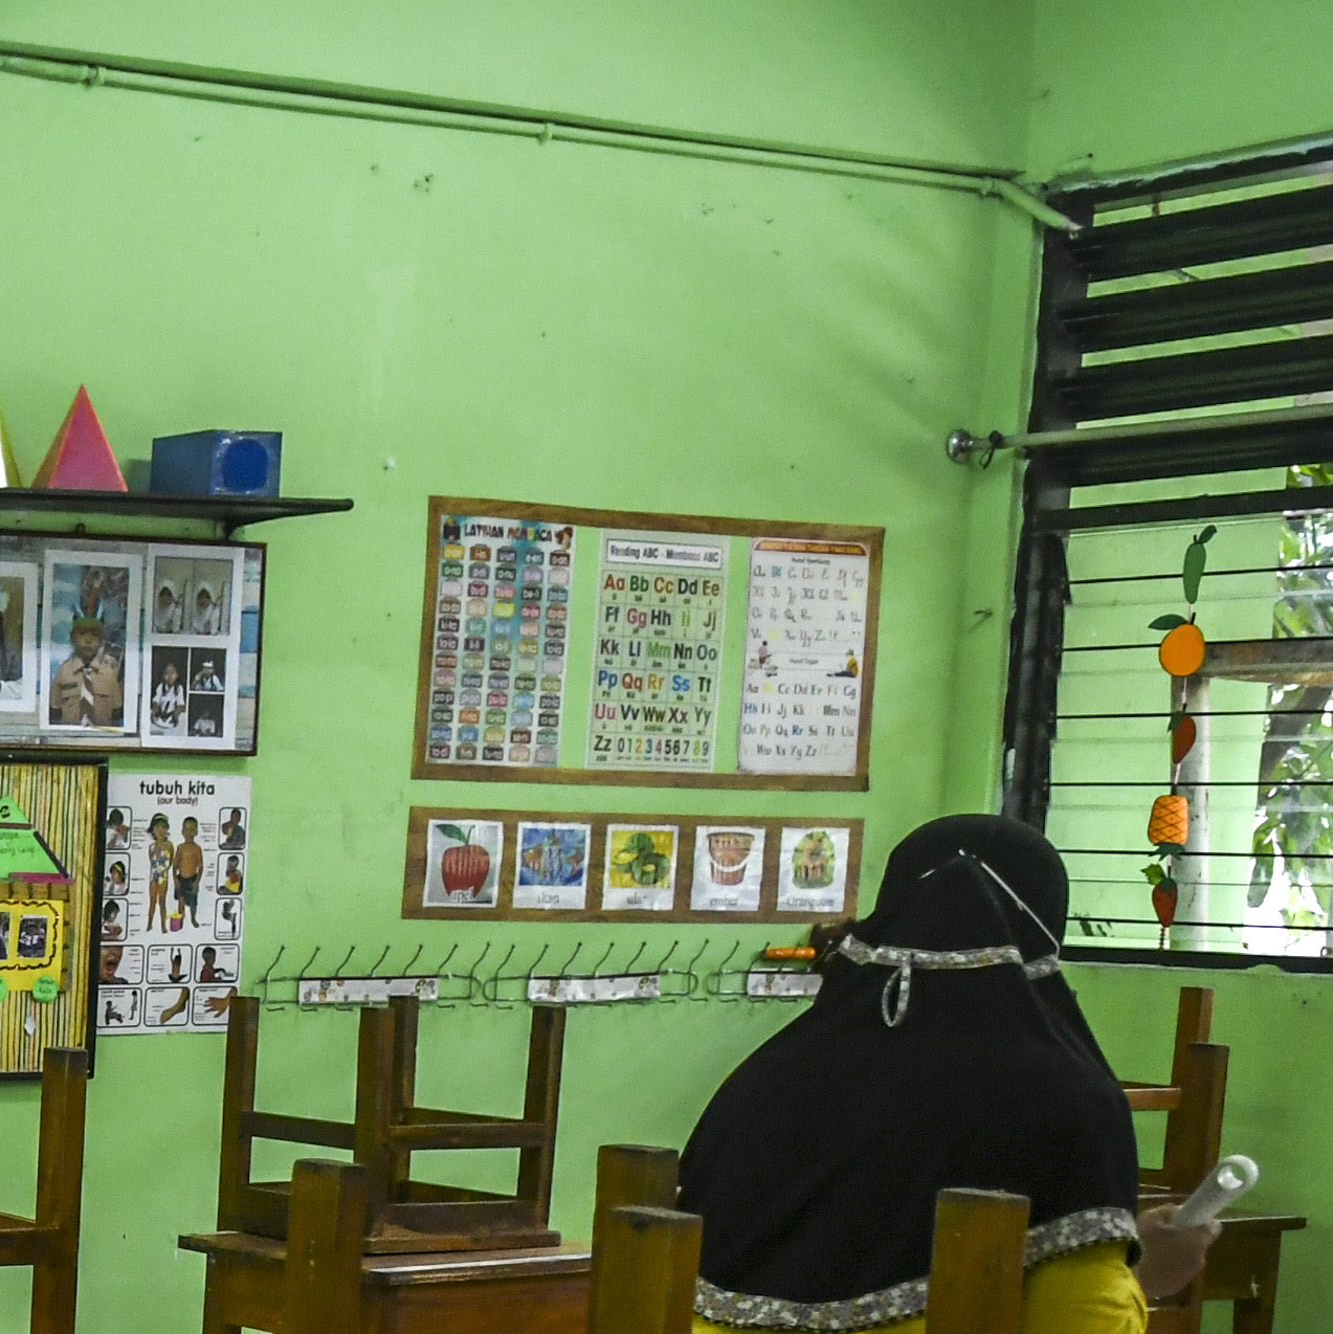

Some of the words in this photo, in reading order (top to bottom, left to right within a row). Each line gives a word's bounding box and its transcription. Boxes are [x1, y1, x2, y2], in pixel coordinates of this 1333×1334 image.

[643, 548, 659, 559] ABC
[604, 573, 626, 591] Aa
[630, 575, 649, 592] Bb
[654, 577, 674, 594] Cc
[678, 578, 698, 595] Dd
[702, 580, 720, 596] Ee
[605, 606, 620, 622] Ff
[627, 608, 647, 628] Gg
[651, 609, 671, 626] Hh
[703, 611, 716, 631] Jj
[600, 639, 620, 655] Kk
[629, 641, 641, 657] Ll
[647, 641, 671, 658] Mm
[674, 643, 692, 660] Nn
[696, 644, 717, 661] Oo
[598, 670, 618, 689] Pp
[622, 673, 643, 692] Qq
[647, 674, 665, 690] Rr
[672, 674, 690, 692] Ss
[698, 677, 712, 692] Tt
[594, 703, 616, 720] Uu
[621, 704, 640, 720] Vv
[643, 706, 666, 722] Ww
[668, 707, 688, 724] Xx
[695, 706, 712, 726] Yy
[594, 735, 612, 752] Zz
[617, 737, 624, 753] 0
[635, 738, 642, 754] 2
[645, 739, 652, 754] 3
[664, 740, 672, 755] 5
[672, 739, 681, 755] 6
[683, 740, 689, 755] 7
[139, 780, 183, 795] tubuh
[188, 780, 215, 796] kita
[157, 796, 174, 805] (our
[175, 796, 199, 807] body)
